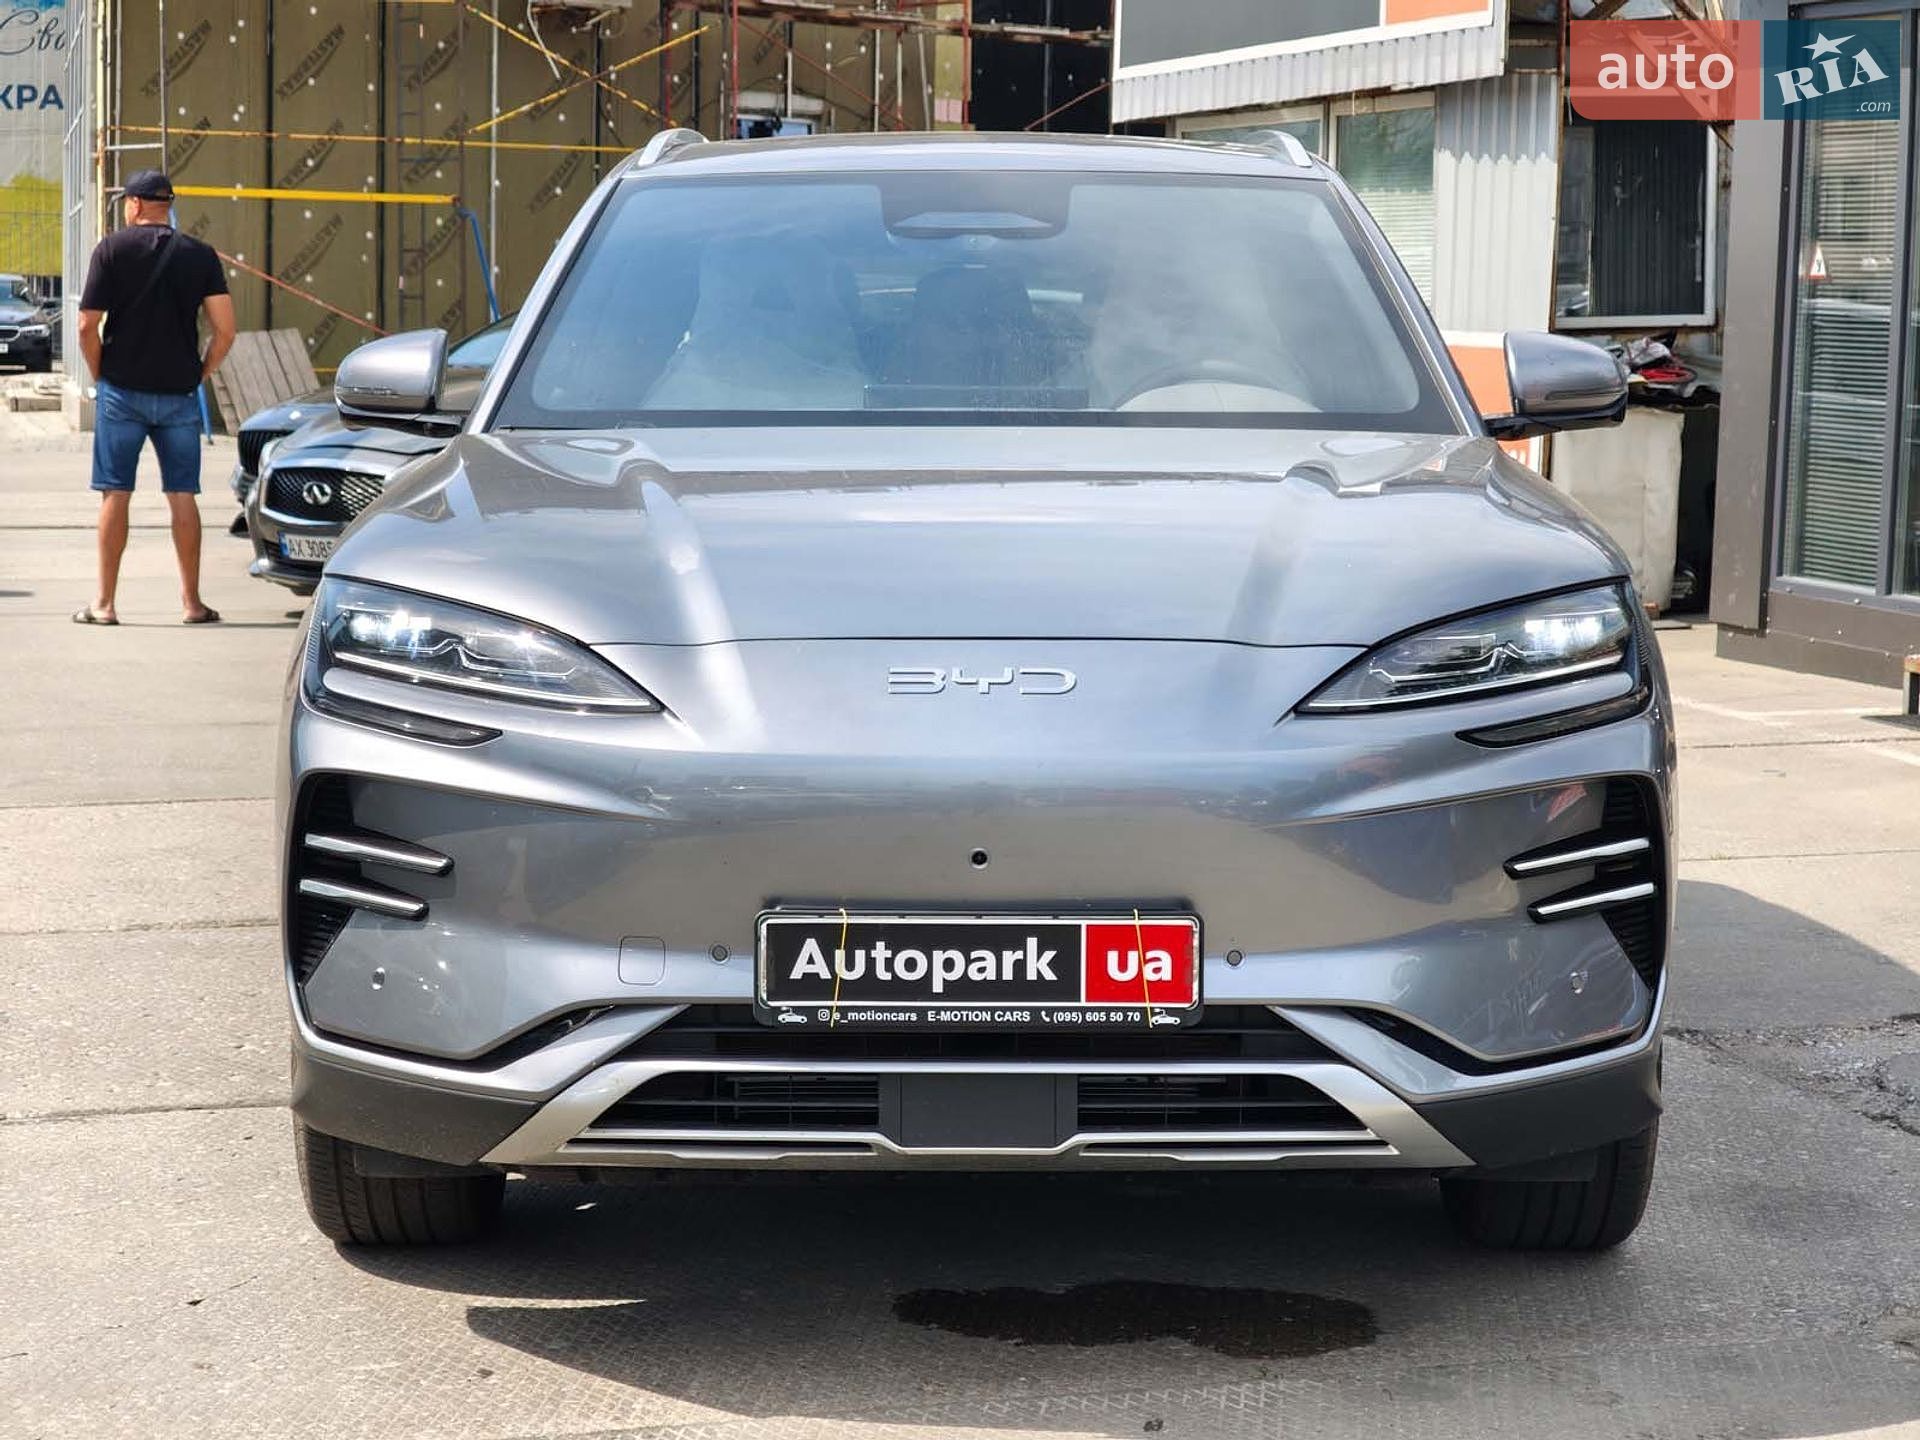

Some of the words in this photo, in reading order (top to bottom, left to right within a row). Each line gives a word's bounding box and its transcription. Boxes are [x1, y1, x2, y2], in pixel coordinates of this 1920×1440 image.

[888, 666, 1077, 695] BYD
[788, 936, 1059, 994] Autopark
[1105, 949, 1173, 983] ua
[927, 1010, 991, 1022] E-MOTION
[994, 1010, 1031, 1022] CARS
[1053, 1010, 1083, 1024] (095)
[1085, 1010, 1107, 1022] 605
[1109, 1010, 1123, 1022] 50
[1126, 1010, 1141, 1022] 70
